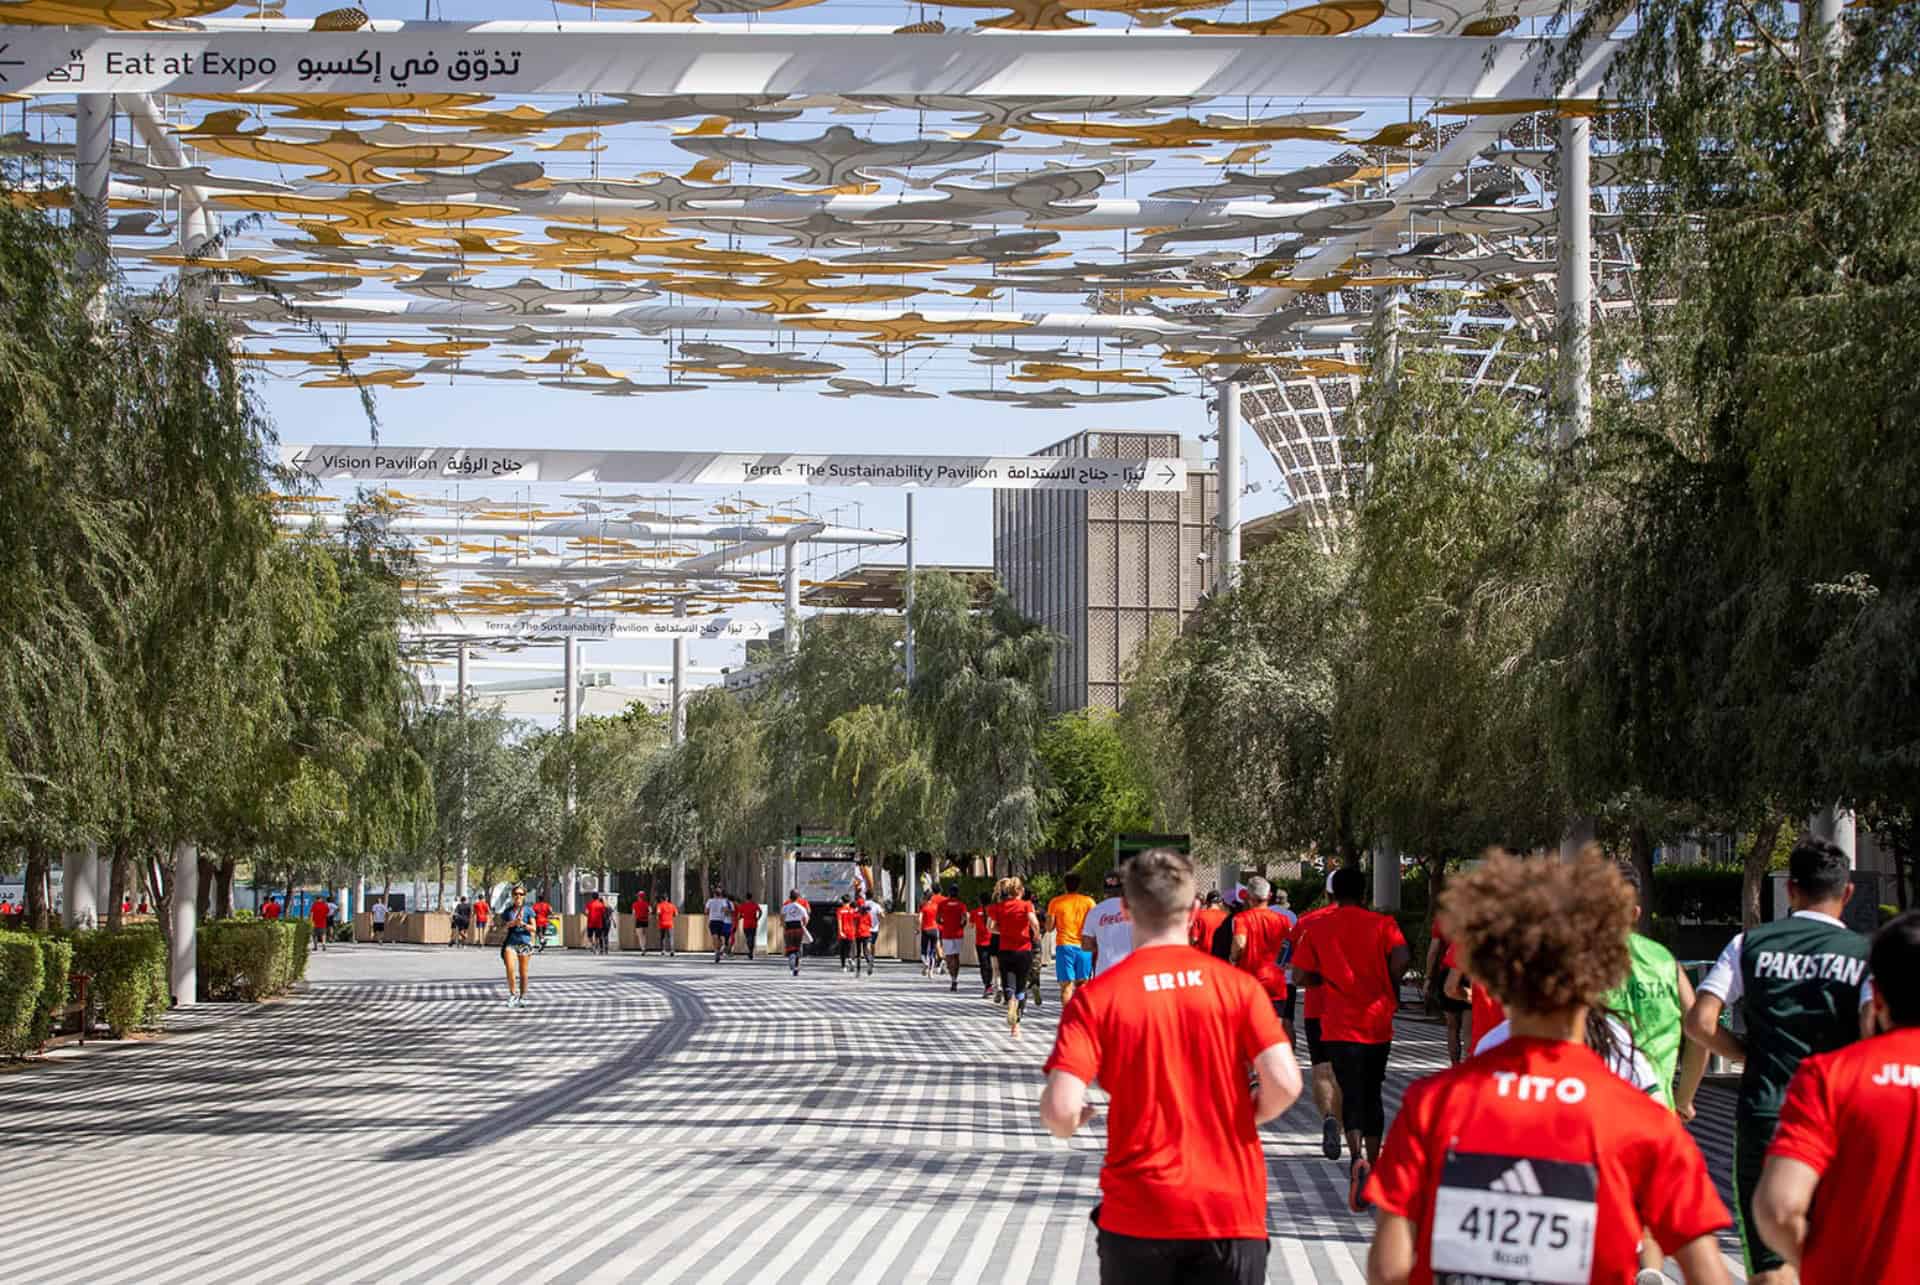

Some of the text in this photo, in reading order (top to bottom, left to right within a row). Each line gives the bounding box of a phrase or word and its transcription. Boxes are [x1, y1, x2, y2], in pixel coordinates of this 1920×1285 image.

[107, 53, 277, 81] Eat at Expo
[297, 50, 381, 83] إكسبو
[390, 51, 440, 88] في
[322, 455, 438, 470] Vision Pavilion
[447, 456, 523, 475] جناح الرؤية
[742, 463, 782, 475] Terra
[798, 464, 825, 476] The
[829, 464, 933, 481] Sustainability
[937, 465, 998, 479] Pavilion
[1008, 466, 1075, 480] الاستدامة
[1079, 468, 1108, 484] جناح
[485, 621, 511, 630] Terra
[520, 621, 538, 631] The
[542, 622, 606, 633] Sustainability
[610, 622, 649, 632] Pavilion
[1754, 952, 1867, 986] PAKISTAN
[1143, 970, 1204, 992] ERIK
[1493, 1071, 1586, 1104] TITO
[1459, 1206, 1570, 1249] 41275
